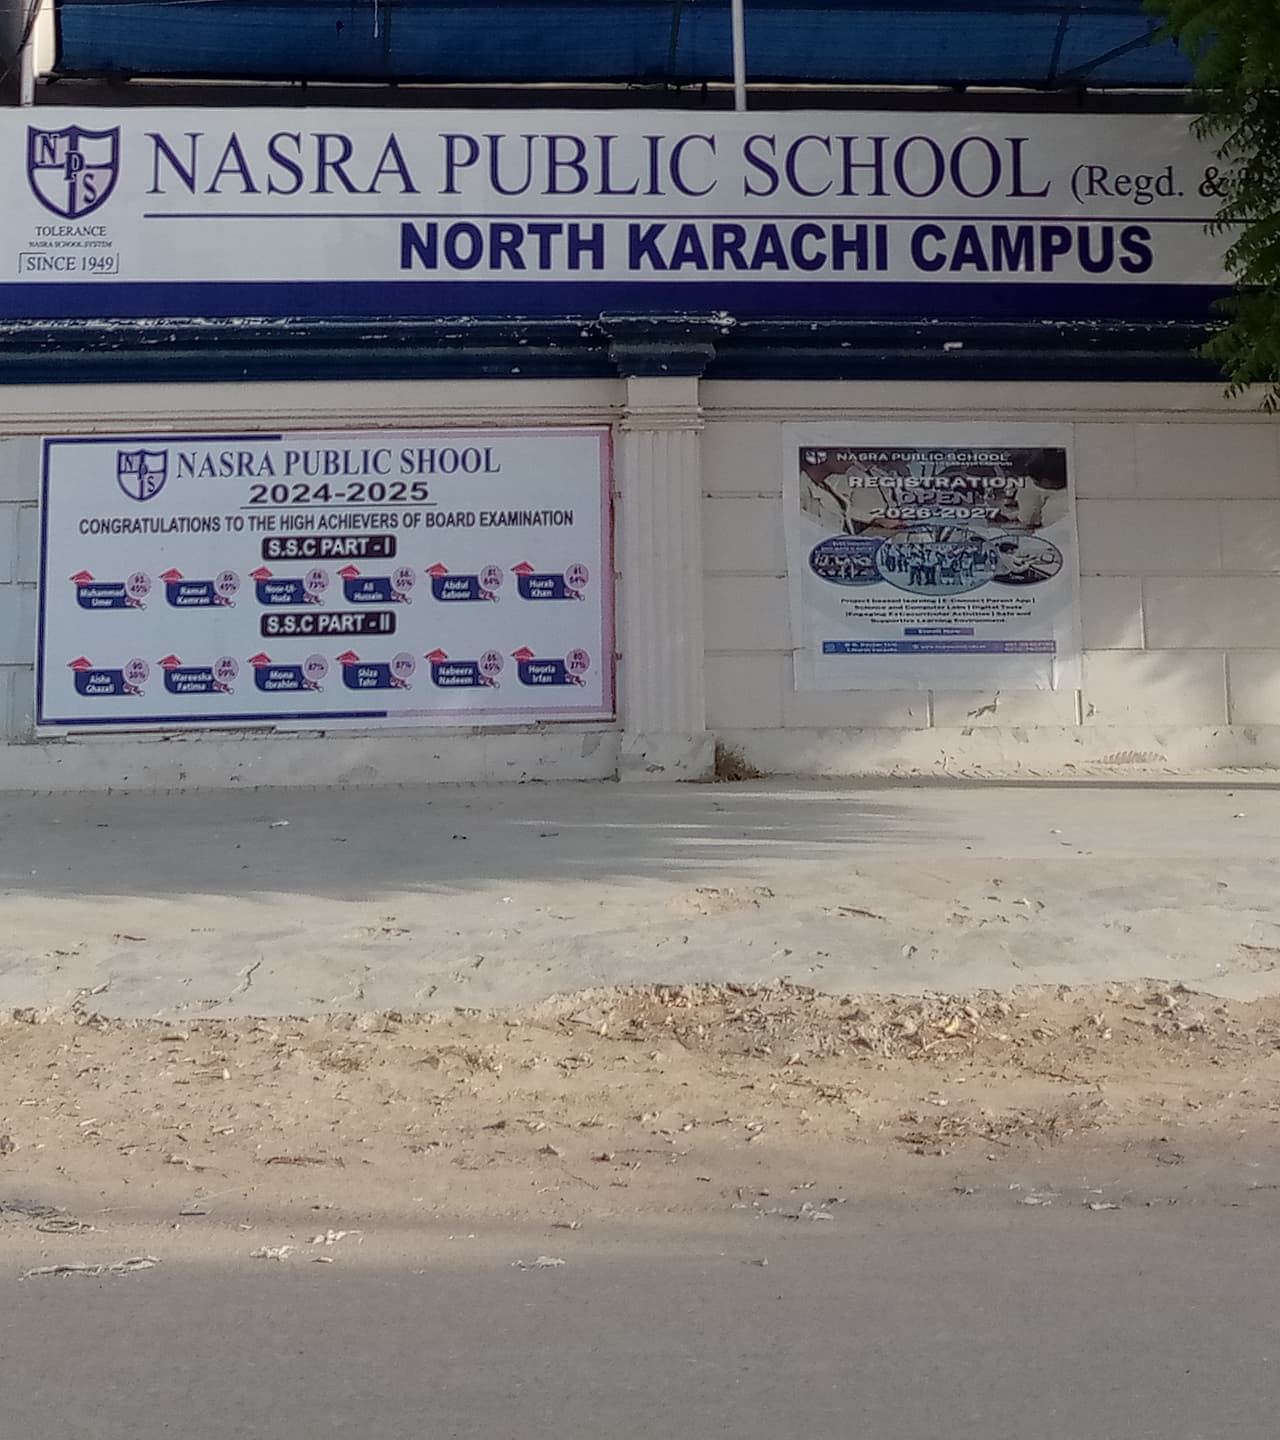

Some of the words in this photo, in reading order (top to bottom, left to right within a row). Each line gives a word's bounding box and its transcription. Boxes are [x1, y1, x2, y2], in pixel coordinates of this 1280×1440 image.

[39, 134, 97, 205] NPS
[143, 132, 421, 197] NASRA
[438, 132, 718, 198] PUBLIC
[743, 134, 1051, 199] SCHOOL
[1071, 163, 1185, 205] (Regd.
[1198, 166, 1230, 198] &
[34, 225, 107, 237] TOLERANCE
[401, 222, 605, 271] NORTH
[628, 223, 889, 272] KARACHI
[910, 223, 1154, 274] CAMPUS
[26, 256, 77, 272] SINCE
[81, 256, 115, 272] 1949
[176, 451, 276, 479] NASRA
[283, 448, 392, 477] PUBLIC
[400, 447, 502, 476] SHOOL
[848, 475, 1025, 489] REGISTRATION
[248, 481, 430, 505] 2024-2025
[898, 490, 974, 505] OPEN
[79, 515, 221, 535] CONGRATULATIONS
[225, 515, 245, 532] TO
[247, 514, 276, 531] THE
[279, 513, 315, 531] HIGH
[317, 511, 399, 530] ACHIEVERS
[402, 511, 422, 528] OF
[425, 510, 476, 528] BOARD
[478, 509, 574, 527] EXAMINATION
[869, 507, 999, 520] 2026-2027
[268, 539, 317, 557] S.S.C
[320, 537, 370, 556] PART
[267, 616, 314, 634] S.S.C
[319, 614, 365, 632] PART
